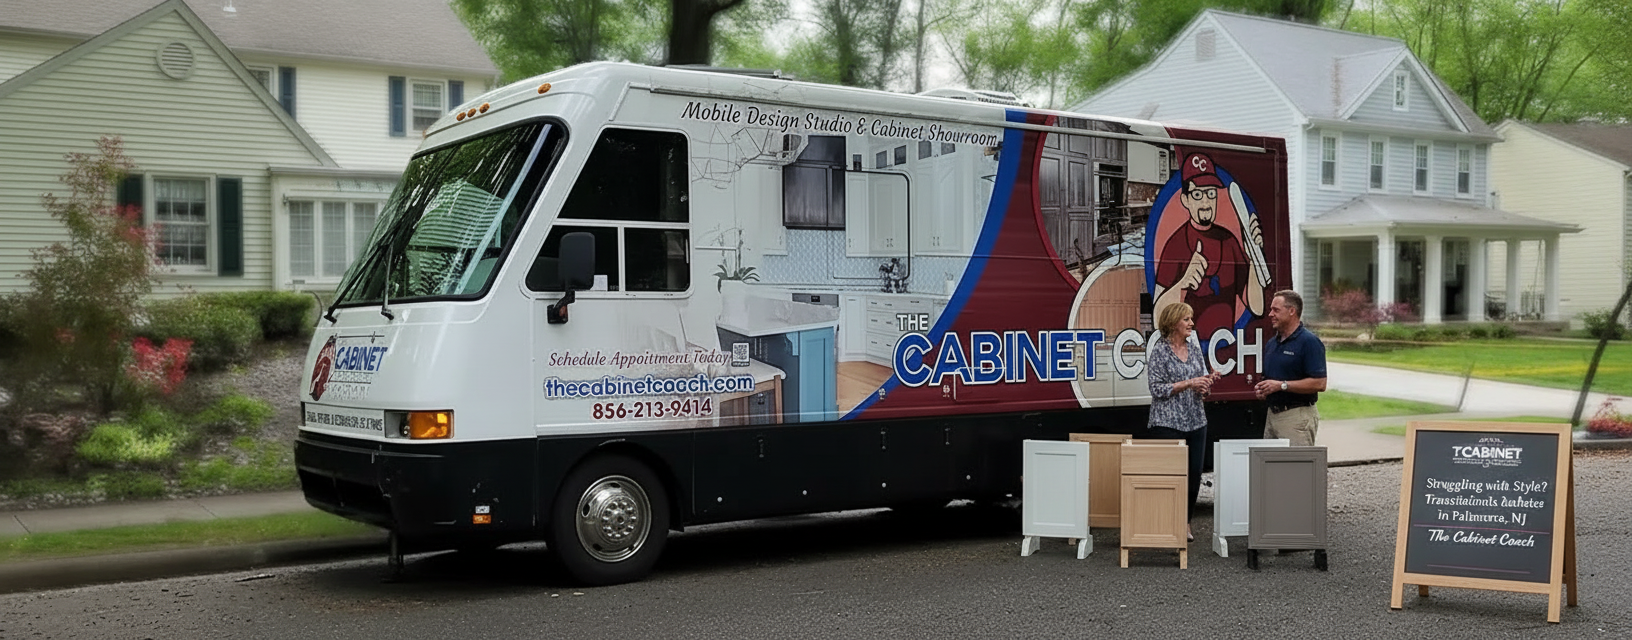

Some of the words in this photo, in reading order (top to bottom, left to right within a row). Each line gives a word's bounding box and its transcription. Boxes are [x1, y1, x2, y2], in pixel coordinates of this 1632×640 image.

[681, 101, 741, 123] Mobile
[747, 106, 799, 132] Design
[804, 112, 852, 132] Studio
[856, 117, 867, 135] &
[871, 119, 924, 139] Cabinet
[896, 313, 929, 331] THE
[334, 346, 388, 371] CABINET
[549, 351, 606, 366] Schedule
[892, 328, 1106, 388] CABINET
[1113, 327, 1263, 379] CCH
[592, 398, 713, 419] 856-213-9414
[1513, 480, 1548, 495] Style?
[1511, 512, 1527, 526] NJ
